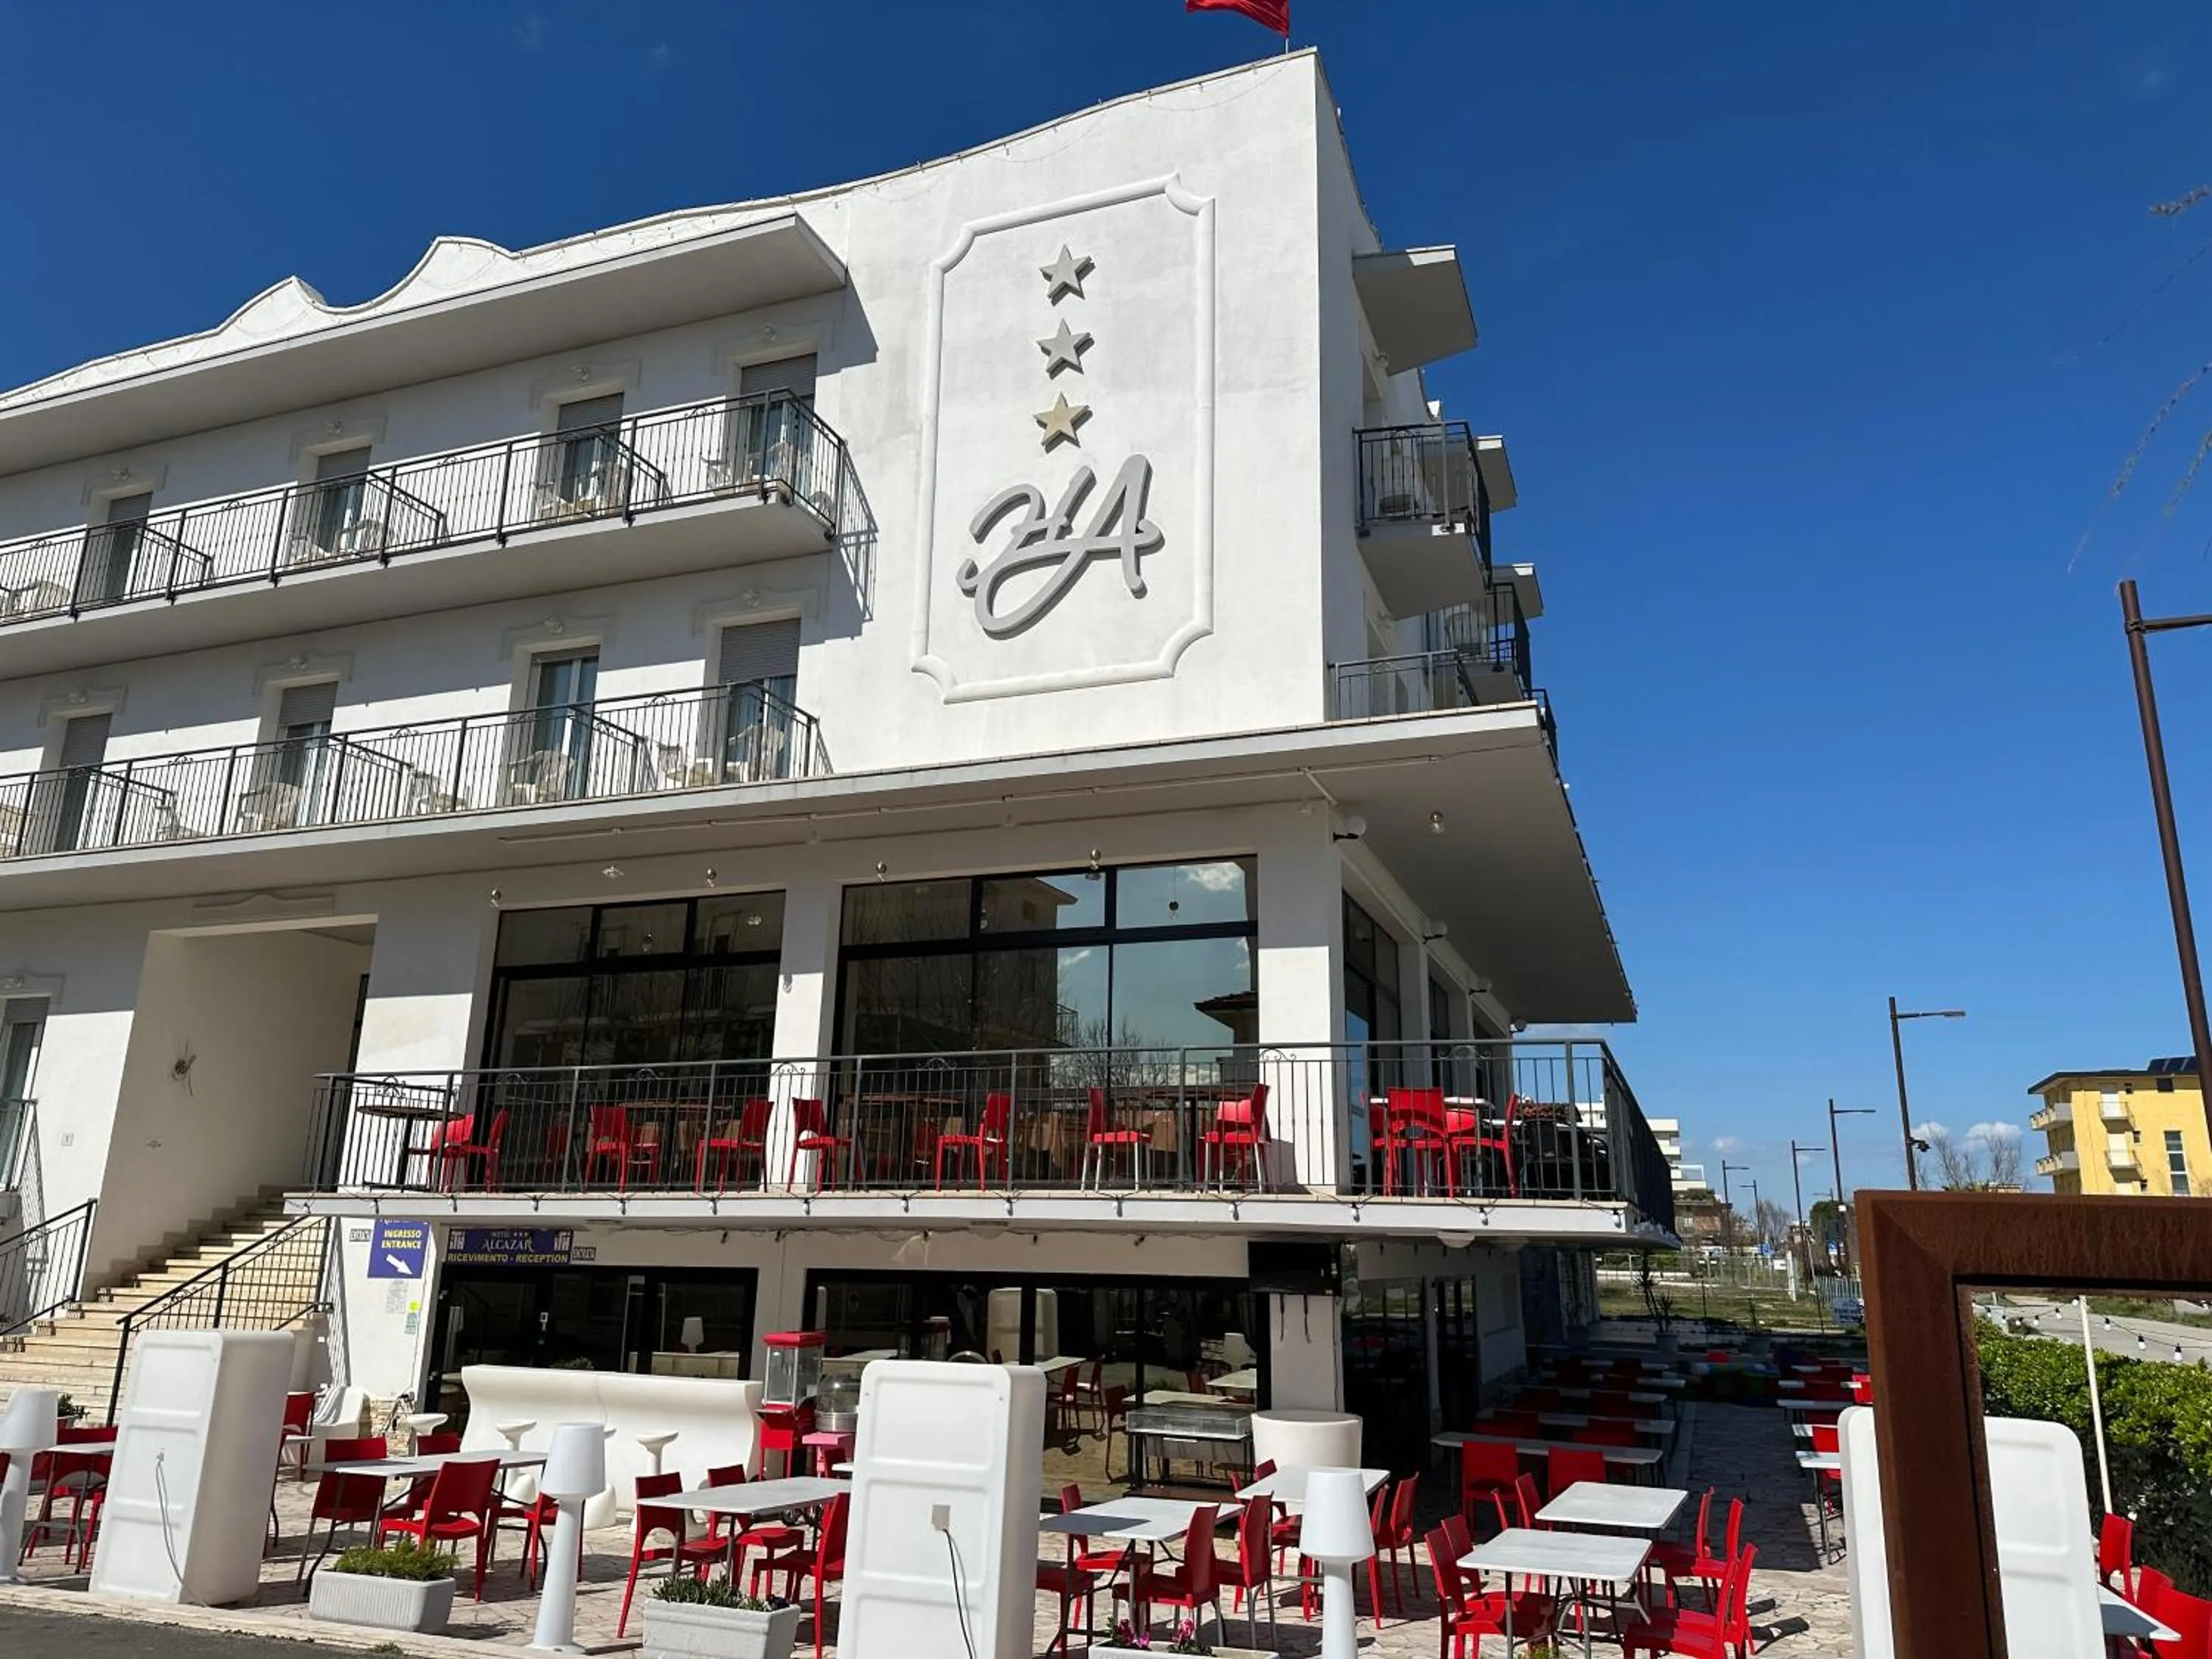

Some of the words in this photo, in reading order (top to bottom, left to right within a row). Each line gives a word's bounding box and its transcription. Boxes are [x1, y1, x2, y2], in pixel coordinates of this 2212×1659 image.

[384, 1229, 422, 1238] INGRESSO
[381, 1239, 421, 1249] ENTRANCE
[482, 1237, 535, 1252] ALCAZAR
[448, 1253, 508, 1262] RICEVIMENTO
[516, 1253, 568, 1263] RECEPTION
